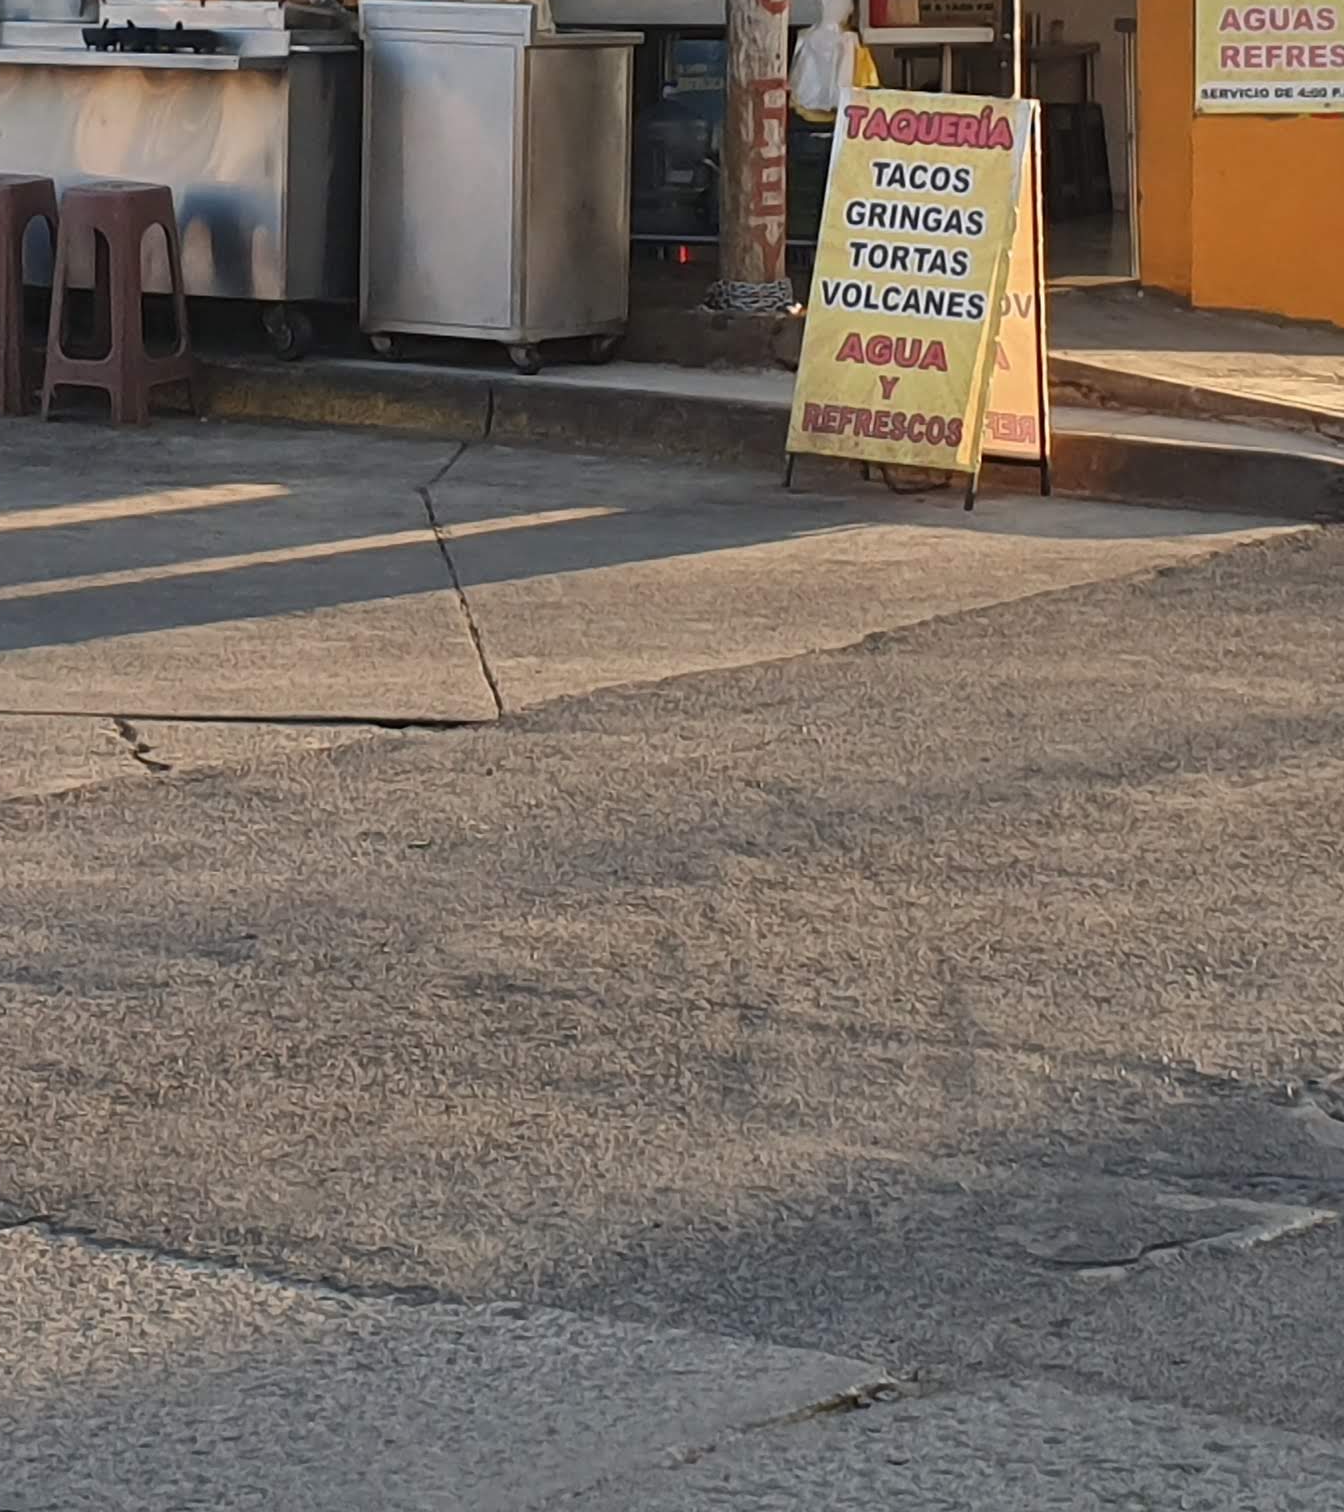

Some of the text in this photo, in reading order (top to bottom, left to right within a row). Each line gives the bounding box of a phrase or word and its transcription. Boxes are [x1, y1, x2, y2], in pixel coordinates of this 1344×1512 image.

[1219, 7, 1336, 32] AGUAS
[844, 104, 1015, 151] TAQUERÍA
[871, 161, 971, 193] TACOS
[845, 200, 985, 236] GRINGAS
[848, 241, 970, 277] TORTAS
[821, 280, 986, 320] VOLCANES
[836, 333, 949, 372] AGUA
[878, 376, 900, 400] Y
[801, 401, 964, 448] REFRESCOS
